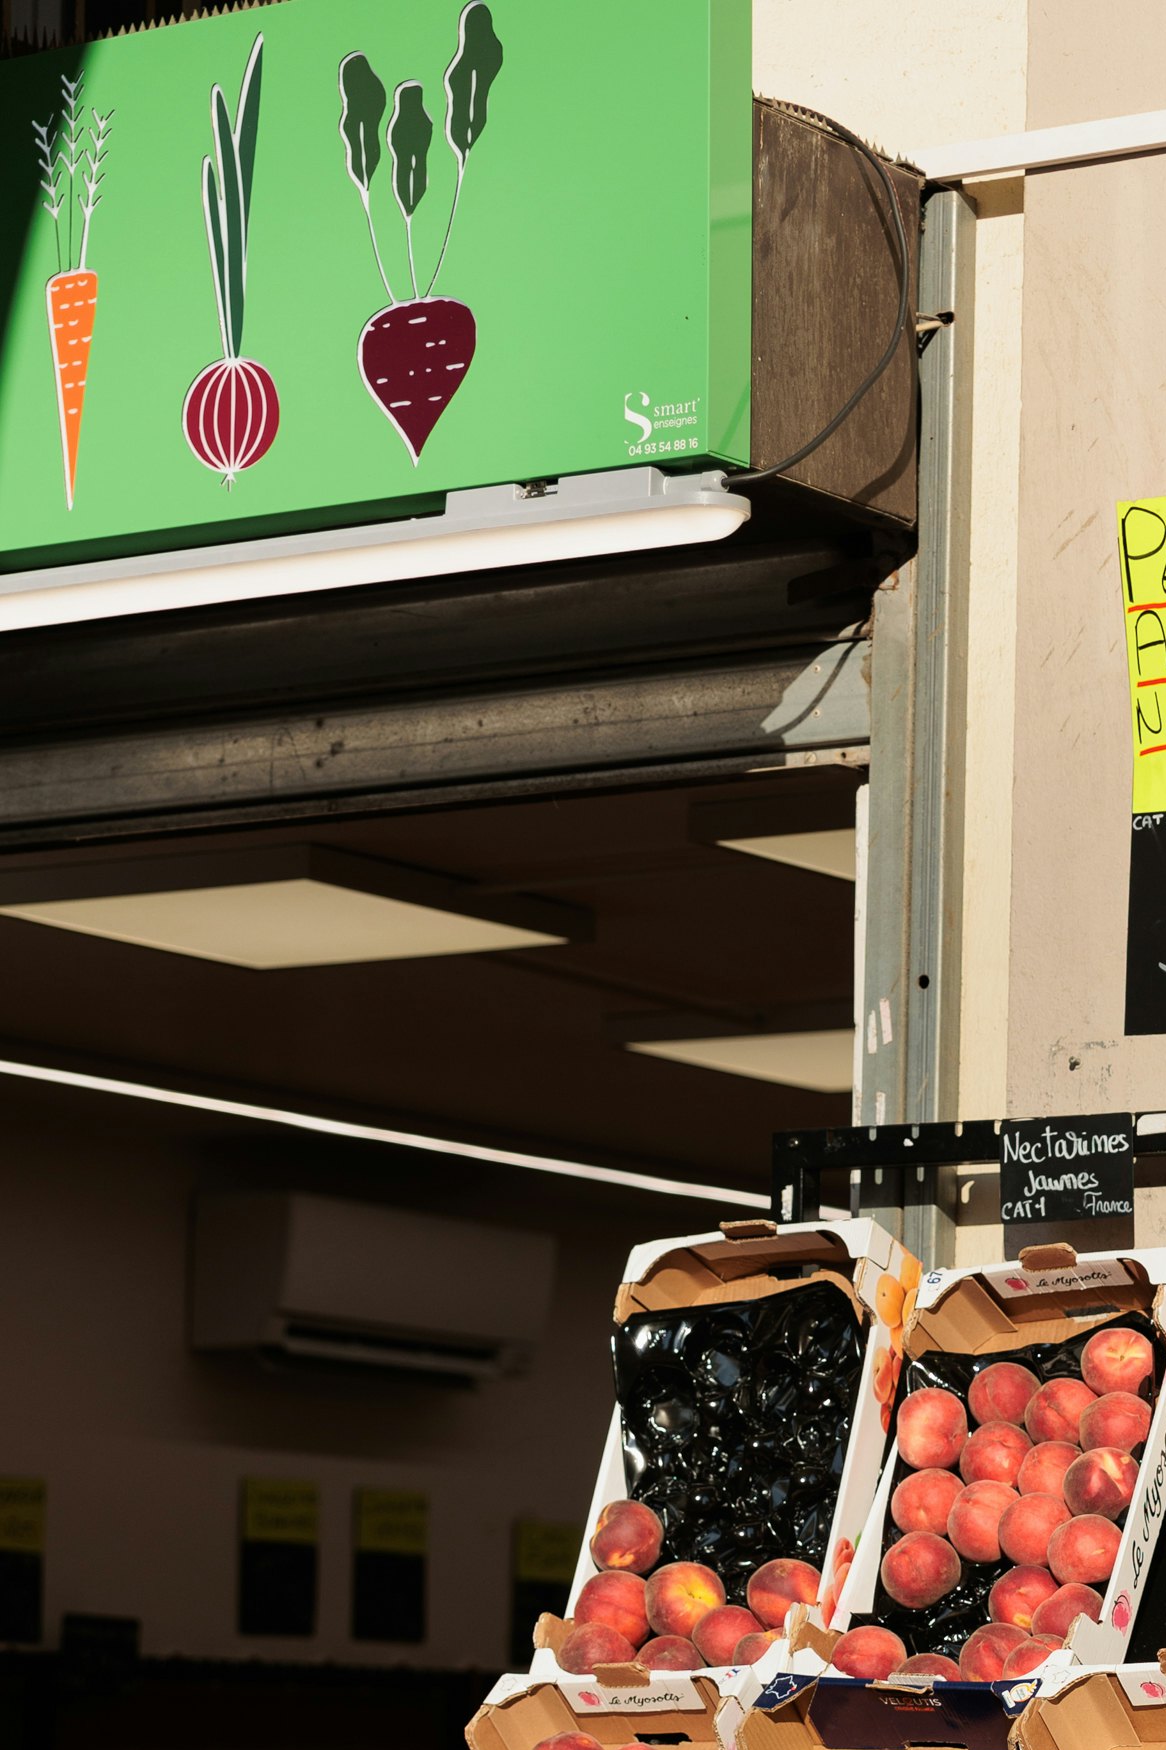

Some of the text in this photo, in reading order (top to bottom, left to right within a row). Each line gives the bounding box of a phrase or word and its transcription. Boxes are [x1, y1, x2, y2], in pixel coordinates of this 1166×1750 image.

[653, 415, 698, 430] enseignes
[628, 437, 699, 456] 04 93 54 88 16
[1003, 1125, 1130, 1164] Nectarines
[1024, 1170, 1099, 1197] Jaunes
[1083, 1192, 1133, 1216] France
[1036, 1271, 1112, 1288] Le Myosotis
[1132, 1540, 1144, 1589] Le
[608, 1691, 684, 1707] Le Myosotis
